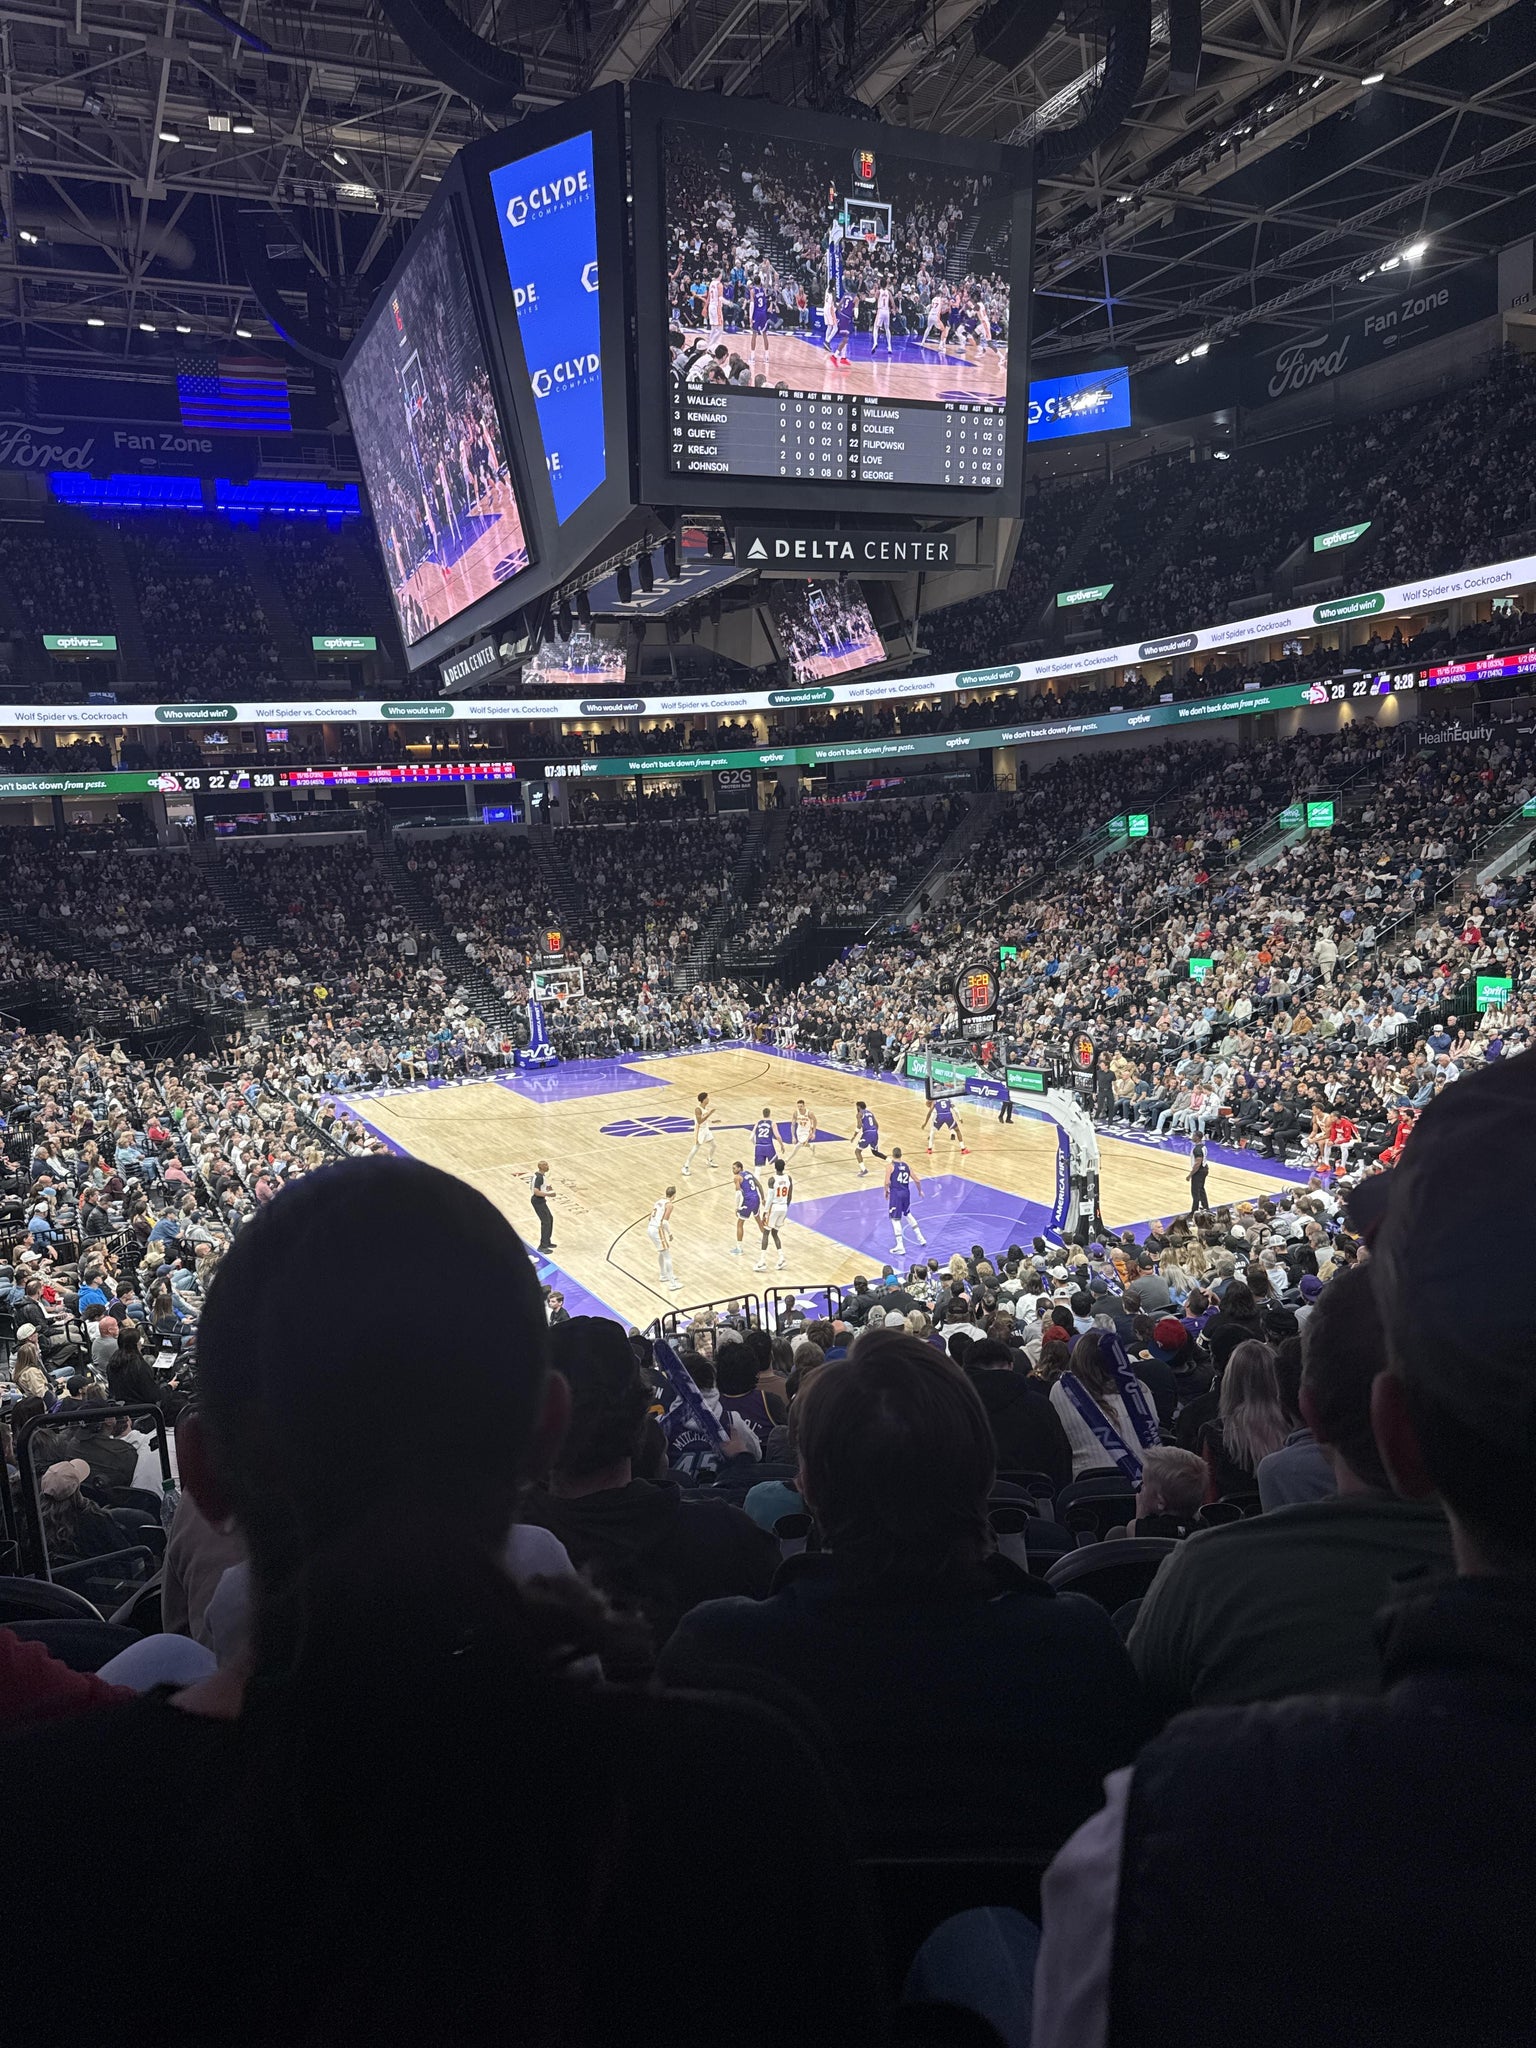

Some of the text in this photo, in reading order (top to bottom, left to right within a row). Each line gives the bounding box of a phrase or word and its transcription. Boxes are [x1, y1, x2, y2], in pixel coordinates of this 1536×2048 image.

[529, 170, 588, 209] CLYDE
[532, 193, 590, 220] COMPANIES
[1364, 310, 1397, 336] Fan
[1401, 288, 1449, 321] Zone
[554, 354, 600, 383] CLYD
[1268, 334, 1350, 398] Ford
[674, 394, 844, 416] 2 WALLACE 0 0 0 00 0
[674, 410, 728, 423] 3 KENNARD
[852, 408, 900, 420] 5 WILLIAMS
[851, 424, 894, 435] 8 COLLIER
[114, 432, 212, 452] Fan Zone
[673, 427, 842, 447] 18 GUEYE 4 1 0 02 1
[0, 421, 94, 470] Ford
[672, 443, 718, 456] 27 KREJCI
[849, 438, 904, 450] 22 FILIPOWSKI
[849, 454, 882, 465] 42 LOVE
[676, 460, 843, 478] 1 JOHNSON 9 3 3 08 0
[851, 470, 1002, 486] 3 GEORGE 5 2 2 08 0
[1322, 534, 1348, 546] aptive
[776, 540, 950, 561] DELTA CENTER
[1402, 590, 1421, 601] Wolf
[1422, 586, 1449, 598] Spider
[1464, 572, 1512, 588] Cockroach
[1066, 591, 1093, 602] aptive
[1320, 599, 1376, 618] Who would win?
[57, 637, 88, 648] aptive
[324, 638, 351, 648] aptive
[1144, 639, 1191, 655] Who would win?
[449, 646, 496, 681] DELTA CENTER
[1035, 665, 1051, 674] Wolf
[1052, 663, 1073, 672] Spider
[1084, 655, 1118, 666] Cockroach
[1394, 674, 1414, 690] 3:28
[1331, 684, 1345, 699] 28
[1353, 682, 1366, 696] 22
[811, 692, 827, 700] win?
[710, 699, 747, 707] Cockroach
[37, 713, 66, 722] Spider
[81, 712, 128, 720] Cockroach
[163, 710, 183, 718] Who
[184, 710, 209, 718] would
[256, 709, 274, 717] Wolf
[276, 709, 302, 717] Spider
[315, 708, 357, 716] Cockroach
[1014, 731, 1030, 739] don't
[1031, 729, 1047, 737] back
[1419, 727, 1493, 744] HealthEquity
[946, 738, 970, 748] aptive
[760, 755, 784, 763] aptive
[828, 749, 845, 757] don't
[659, 760, 676, 768] back
[545, 765, 580, 777] 07:36 PM
[718, 770, 752, 784] G2G
[16, 782, 38, 790] back
[63, 781, 84, 790] from
[85, 782, 107, 790] pests.
[184, 777, 200, 789] 28
[209, 776, 224, 788] 22
[254, 774, 274, 787] 3:28
[968, 974, 988, 987] 3:28
[972, 986, 988, 1007] 19
[336, 1072, 524, 1101] UTAH JAZZ
[758, 1128, 770, 1138] 22
[897, 1172, 909, 1184] 42
[748, 1180, 756, 1191] 3
[776, 1187, 788, 1197] 18
[1055, 1178, 1065, 1222] AMERICA
